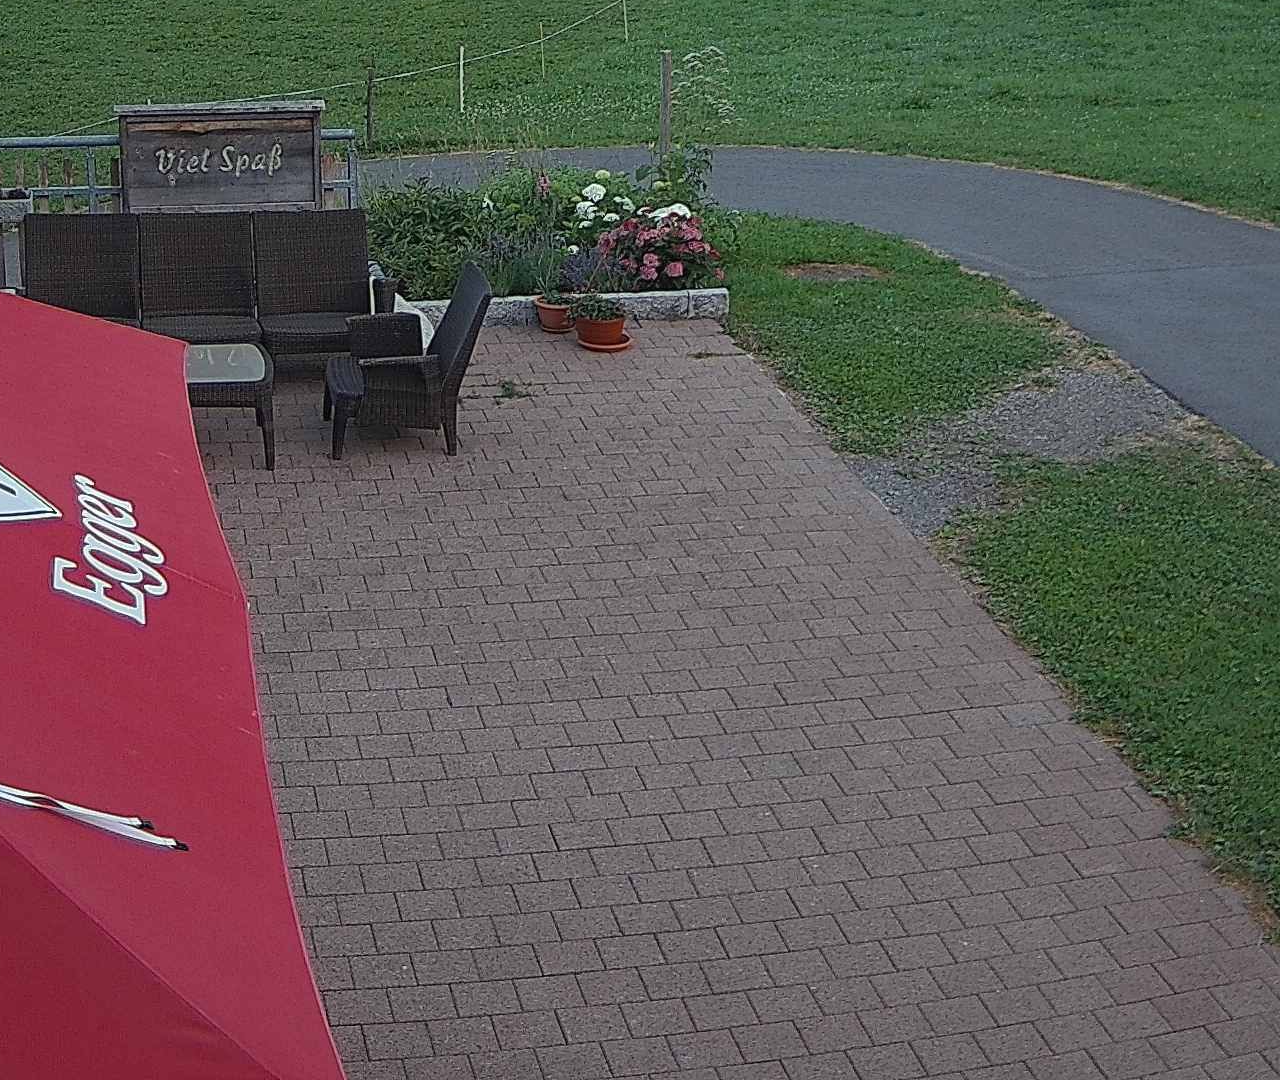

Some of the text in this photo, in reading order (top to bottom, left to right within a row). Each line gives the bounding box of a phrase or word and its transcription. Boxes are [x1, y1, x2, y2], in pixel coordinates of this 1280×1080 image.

[155, 143, 283, 178] Viel Spaß
[51, 472, 169, 626] Egger
